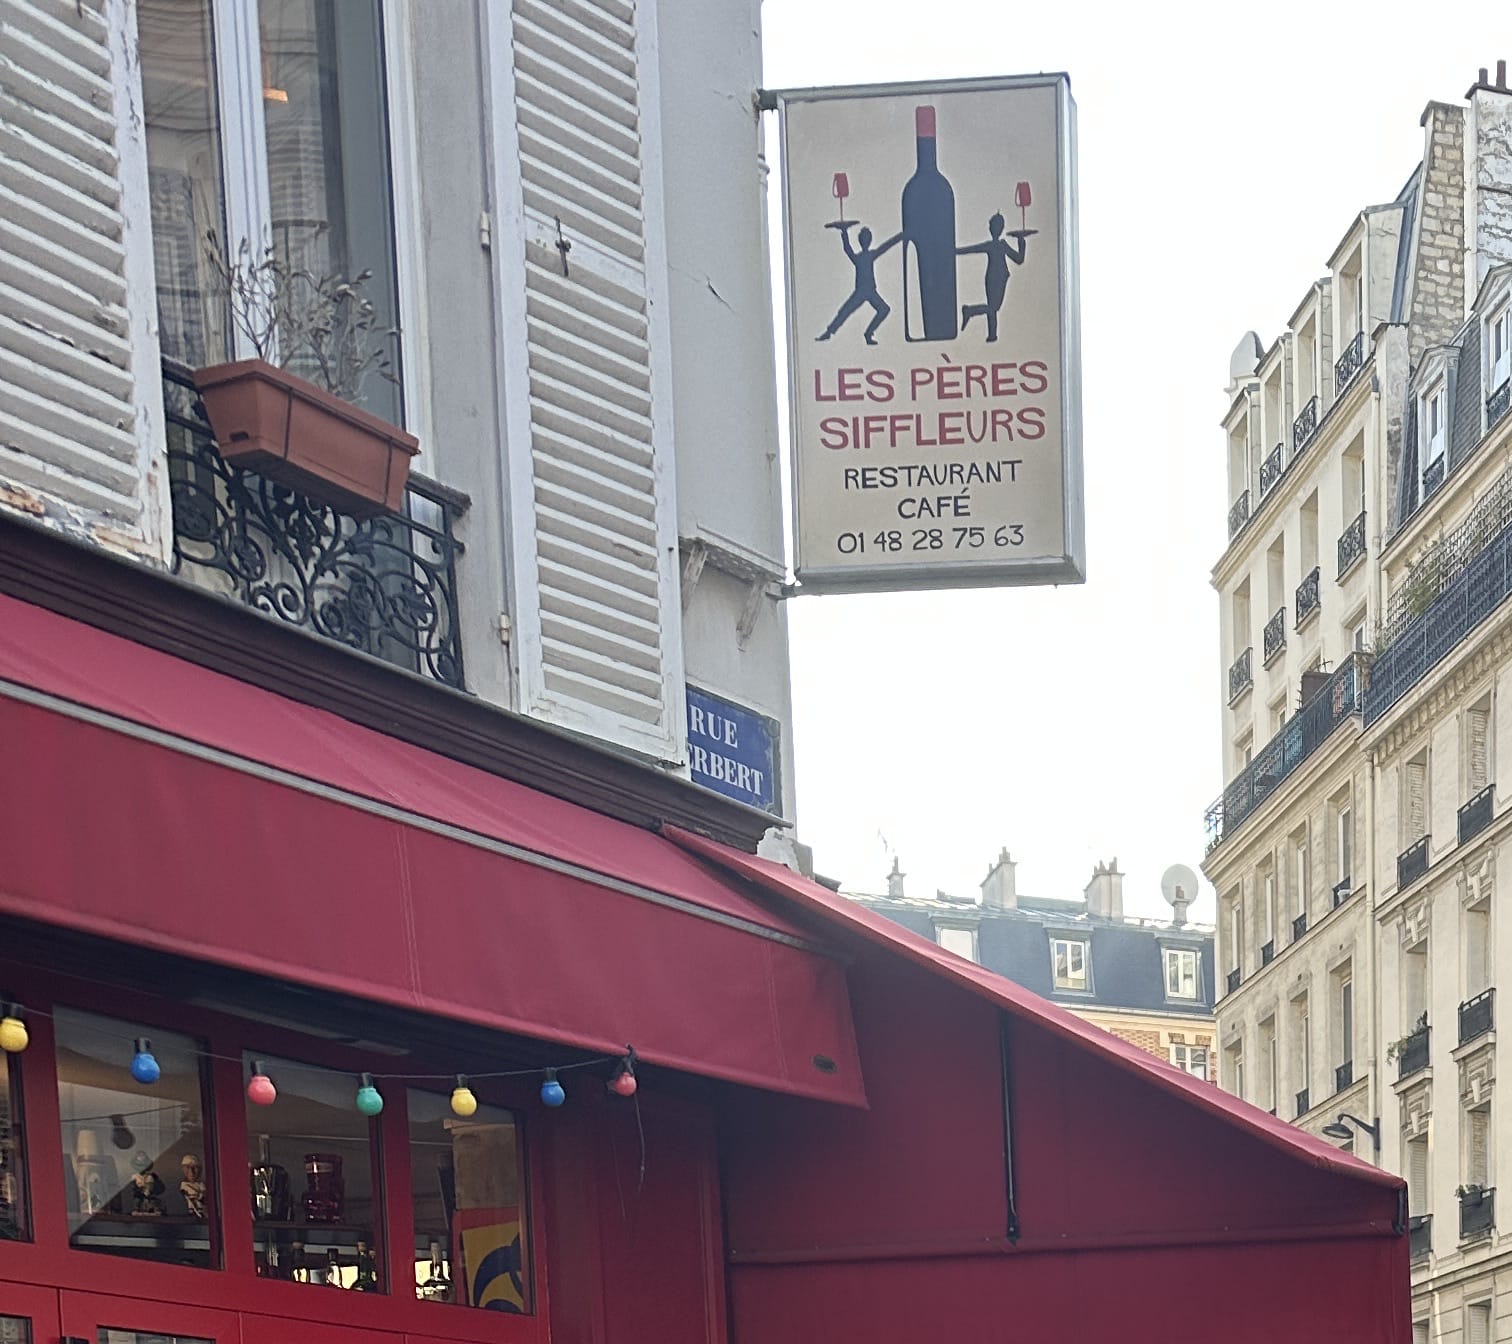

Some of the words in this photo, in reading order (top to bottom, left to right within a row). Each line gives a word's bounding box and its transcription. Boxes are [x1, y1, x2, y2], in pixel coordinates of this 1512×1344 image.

[814, 368, 894, 403] LES
[910, 354, 1048, 400] PÈRES
[819, 406, 1046, 450] SIFFLEURS
[844, 459, 1023, 490] RESTAURANT
[897, 487, 972, 520] CAFÉ
[837, 532, 865, 555] 01
[873, 529, 903, 553] 48
[912, 527, 945, 551] 28
[952, 525, 985, 550] 75
[994, 523, 1025, 548] 63
[689, 703, 738, 749] RUE
